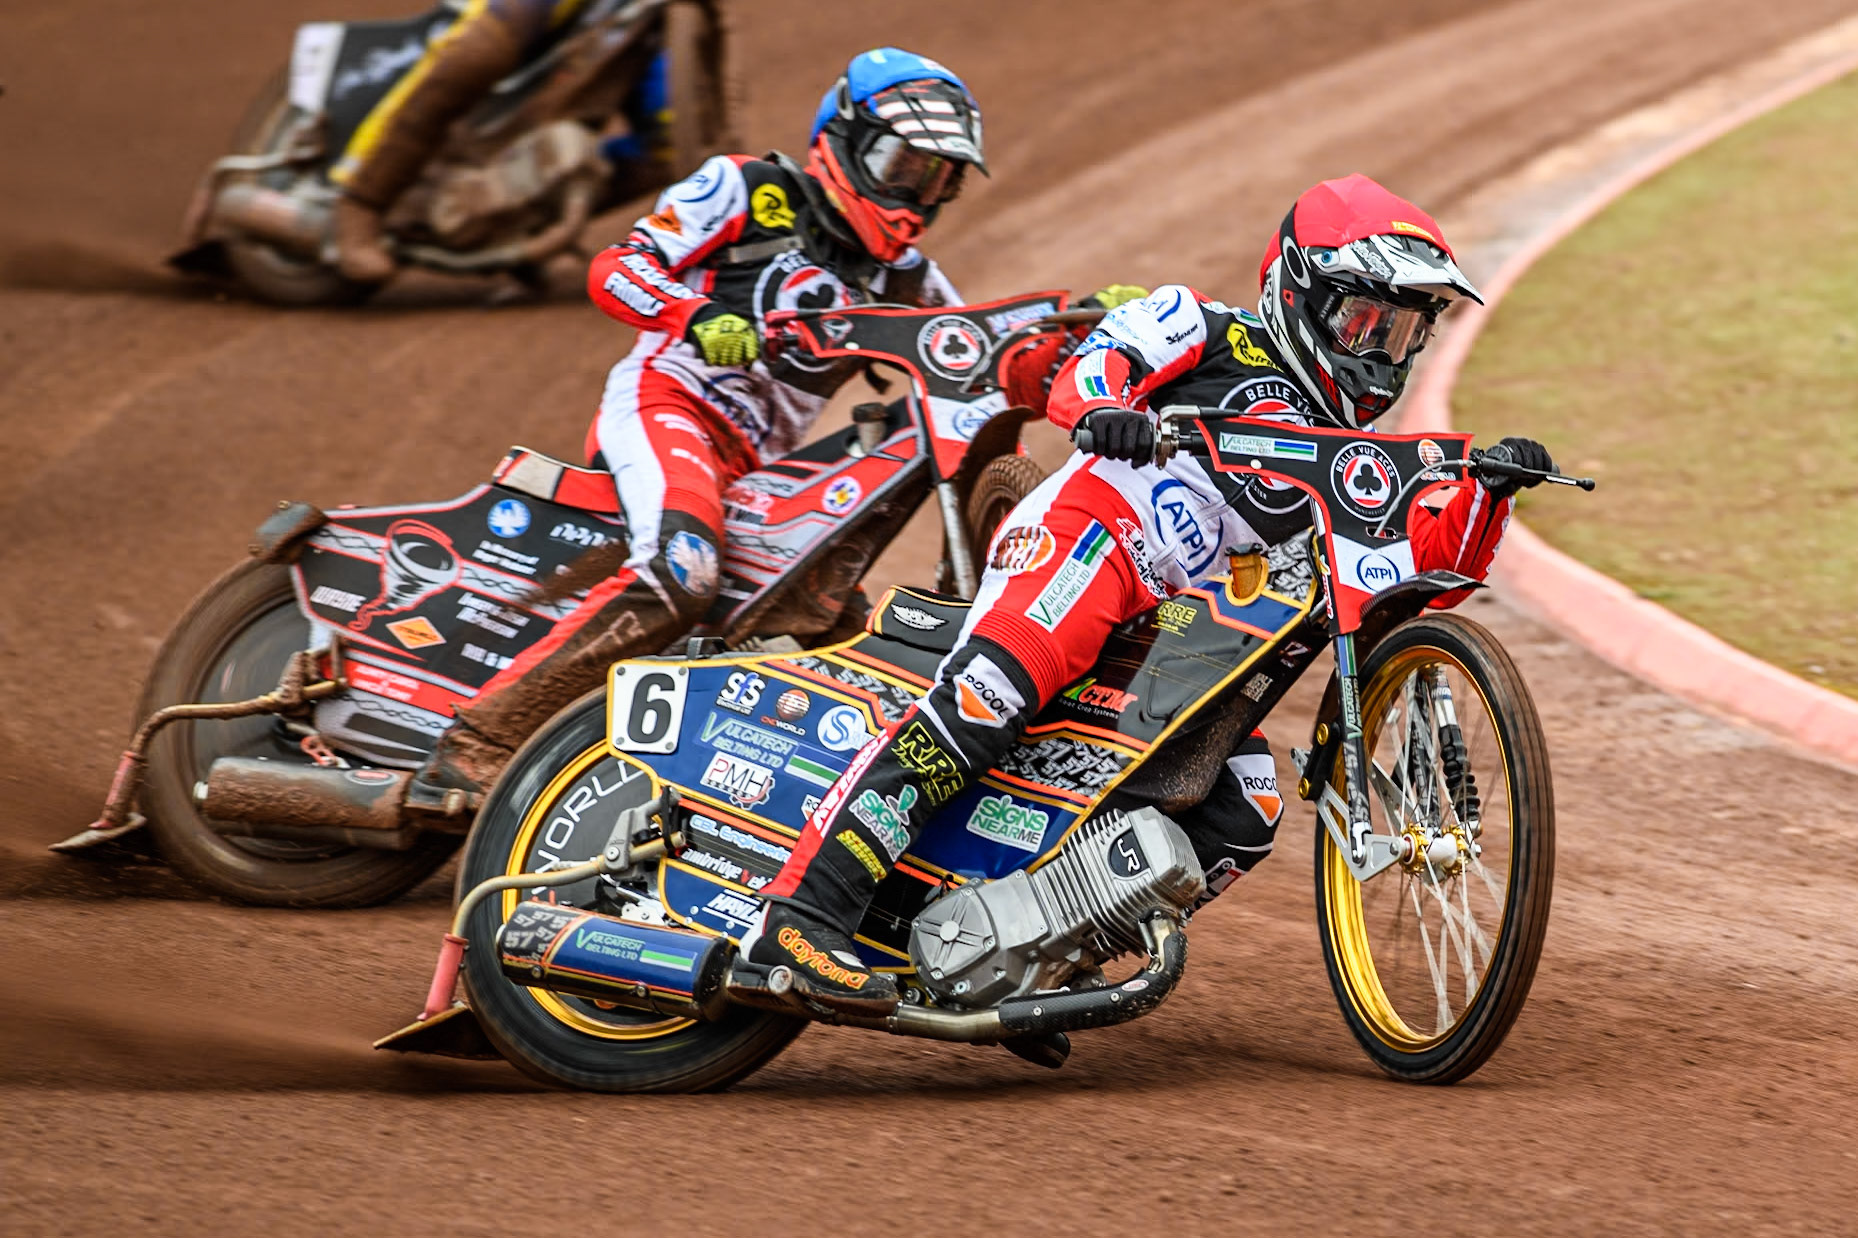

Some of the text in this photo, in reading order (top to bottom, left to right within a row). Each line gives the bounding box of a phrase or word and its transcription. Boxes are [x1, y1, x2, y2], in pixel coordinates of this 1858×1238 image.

[1245, 383, 1291, 402] BELLE
[1335, 446, 1396, 478] BELLE VUE ACES
[1161, 500, 1207, 561] ATPI
[1364, 563, 1393, 580] ATPI
[1029, 563, 1079, 626] VULCATECH
[1052, 568, 1091, 618] BELTING LTD
[1157, 600, 1198, 625] RRE
[627, 672, 676, 744] 6
[1077, 703, 1092, 714] Crop
[1092, 707, 1119, 720] Systems
[1078, 684, 1138, 713] CTM
[700, 711, 793, 756] VULCATECH
[711, 735, 785, 769] BELTING LTD
[898, 720, 965, 802] RRE
[707, 757, 770, 793] PMH
[852, 802, 888, 840] NEAR
[576, 928, 643, 951] VULCATECH
[585, 943, 639, 961] BELTING LTD
[778, 926, 870, 990] daytona
